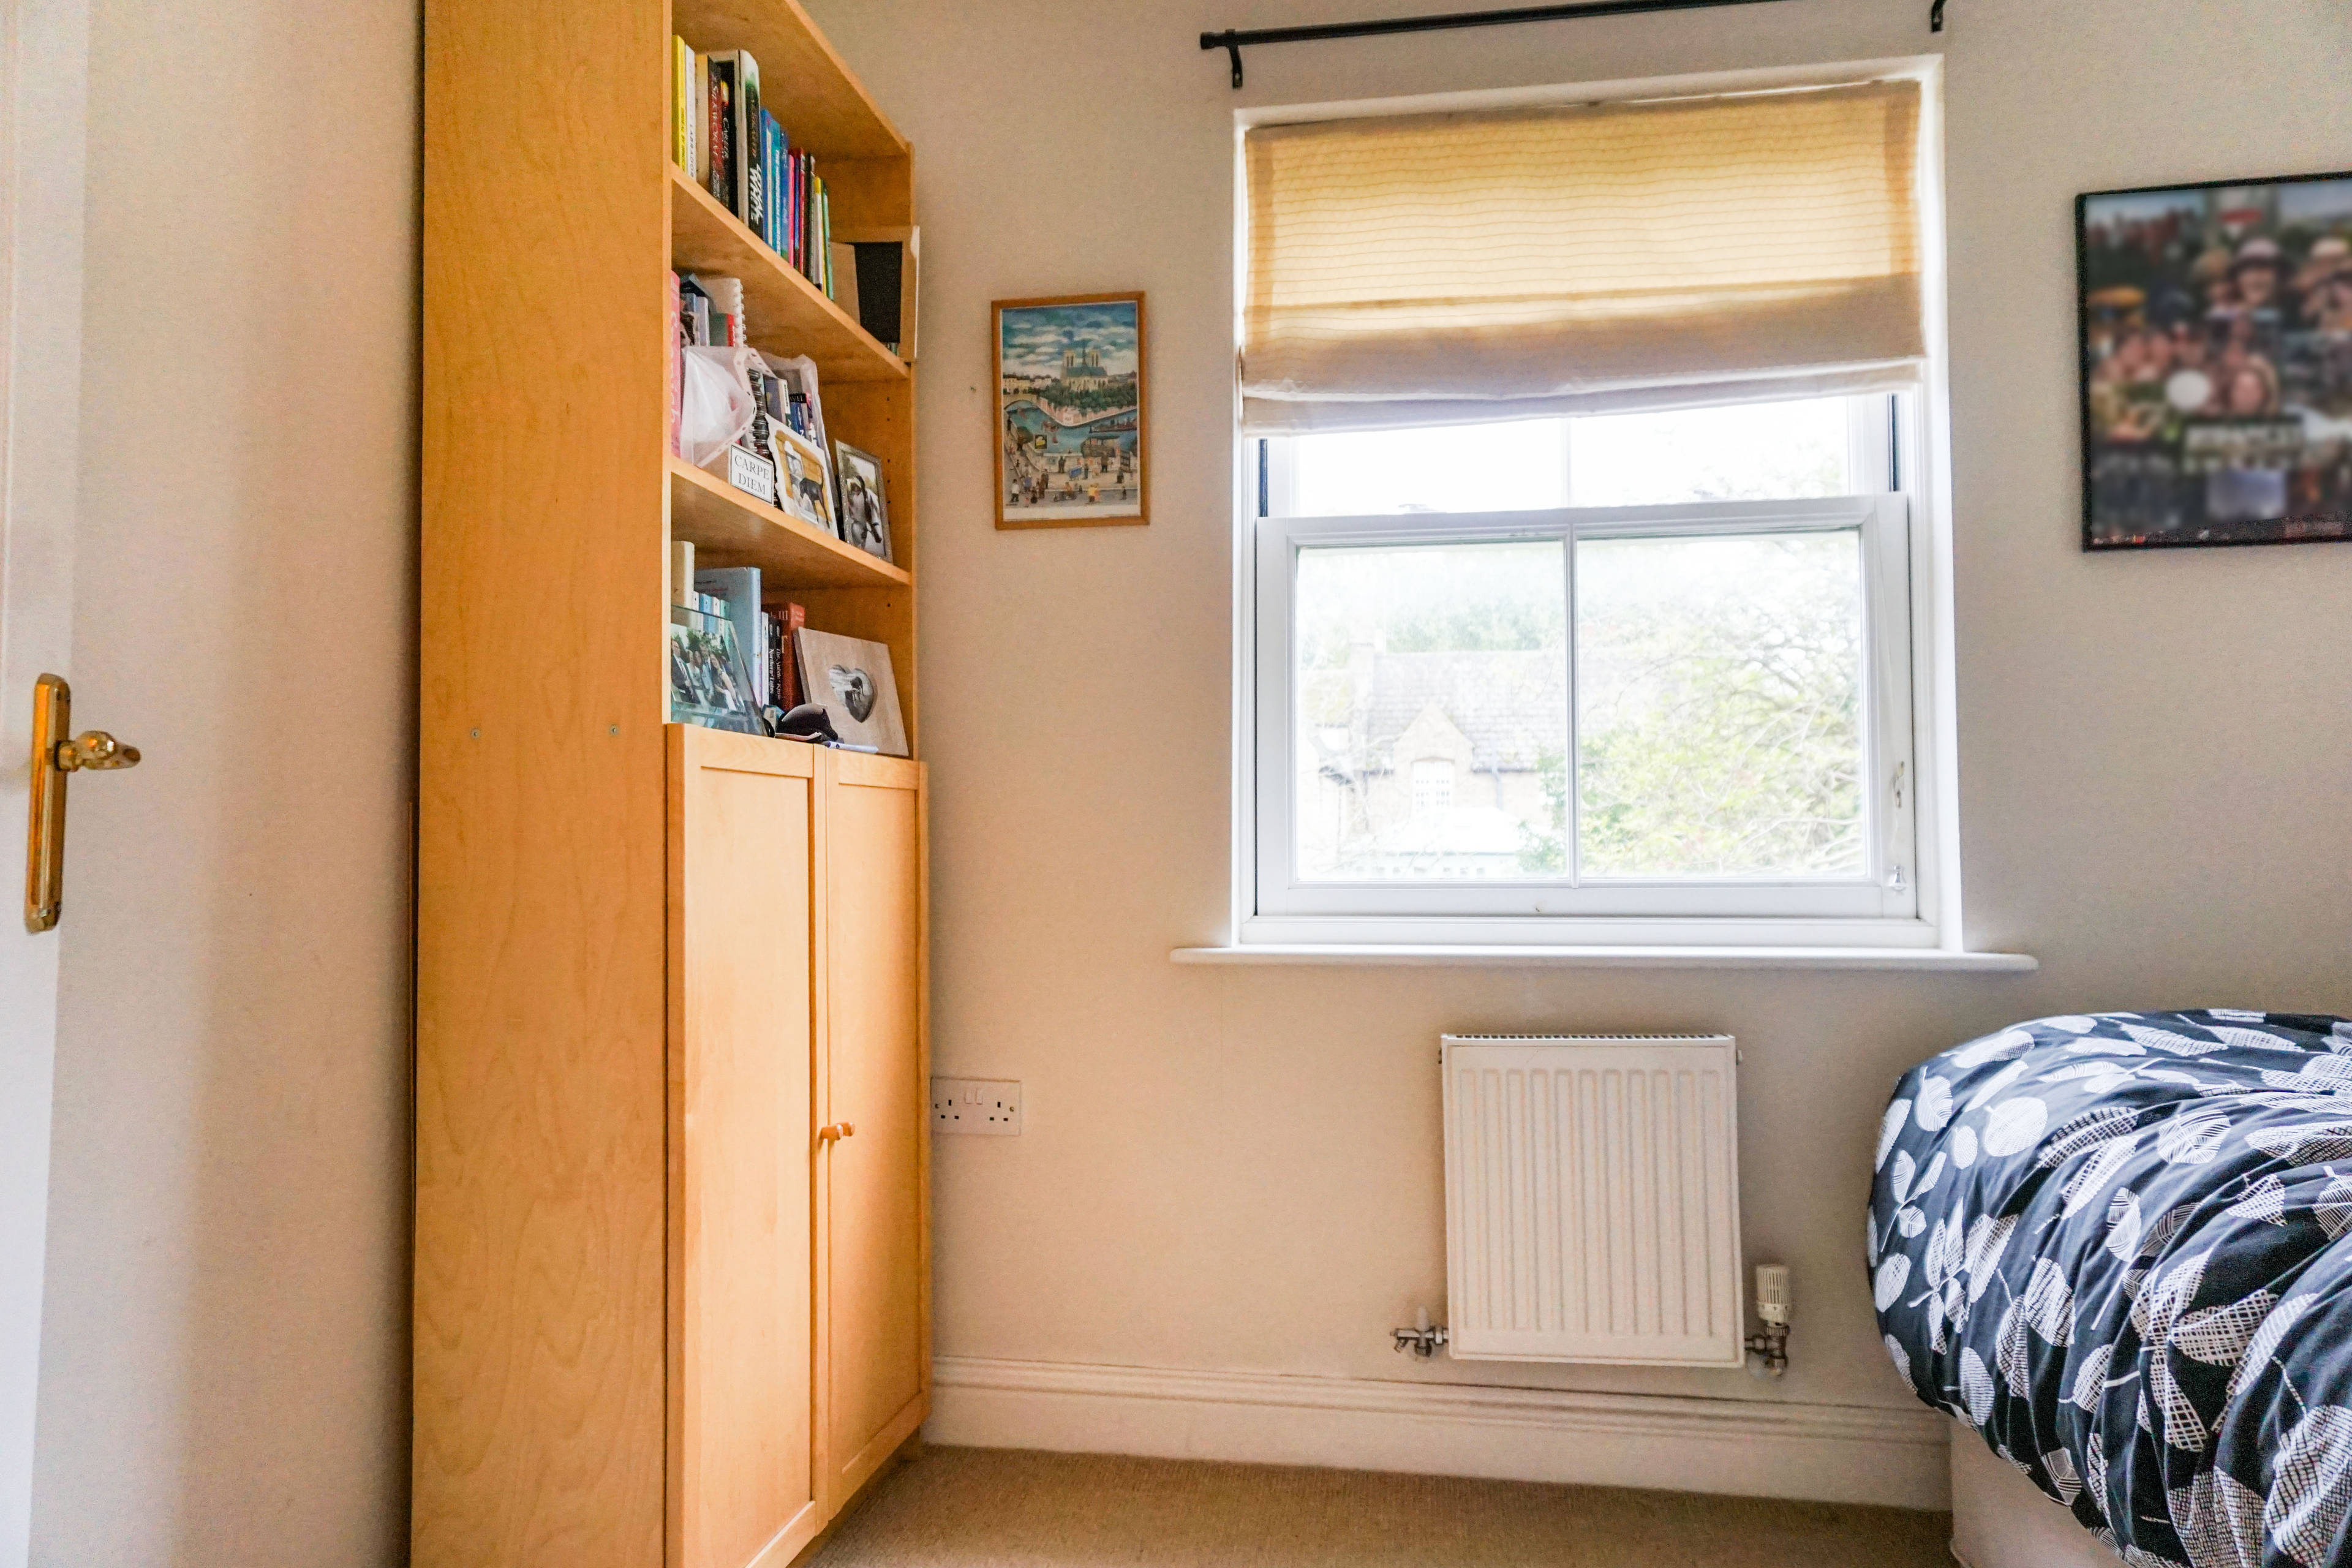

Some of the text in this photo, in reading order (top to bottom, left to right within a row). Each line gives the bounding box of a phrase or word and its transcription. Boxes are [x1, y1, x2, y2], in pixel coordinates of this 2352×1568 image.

[750, 167, 760, 225] WHITE
[734, 454, 770, 480] CARPE
[739, 472, 766, 495] DIEM
